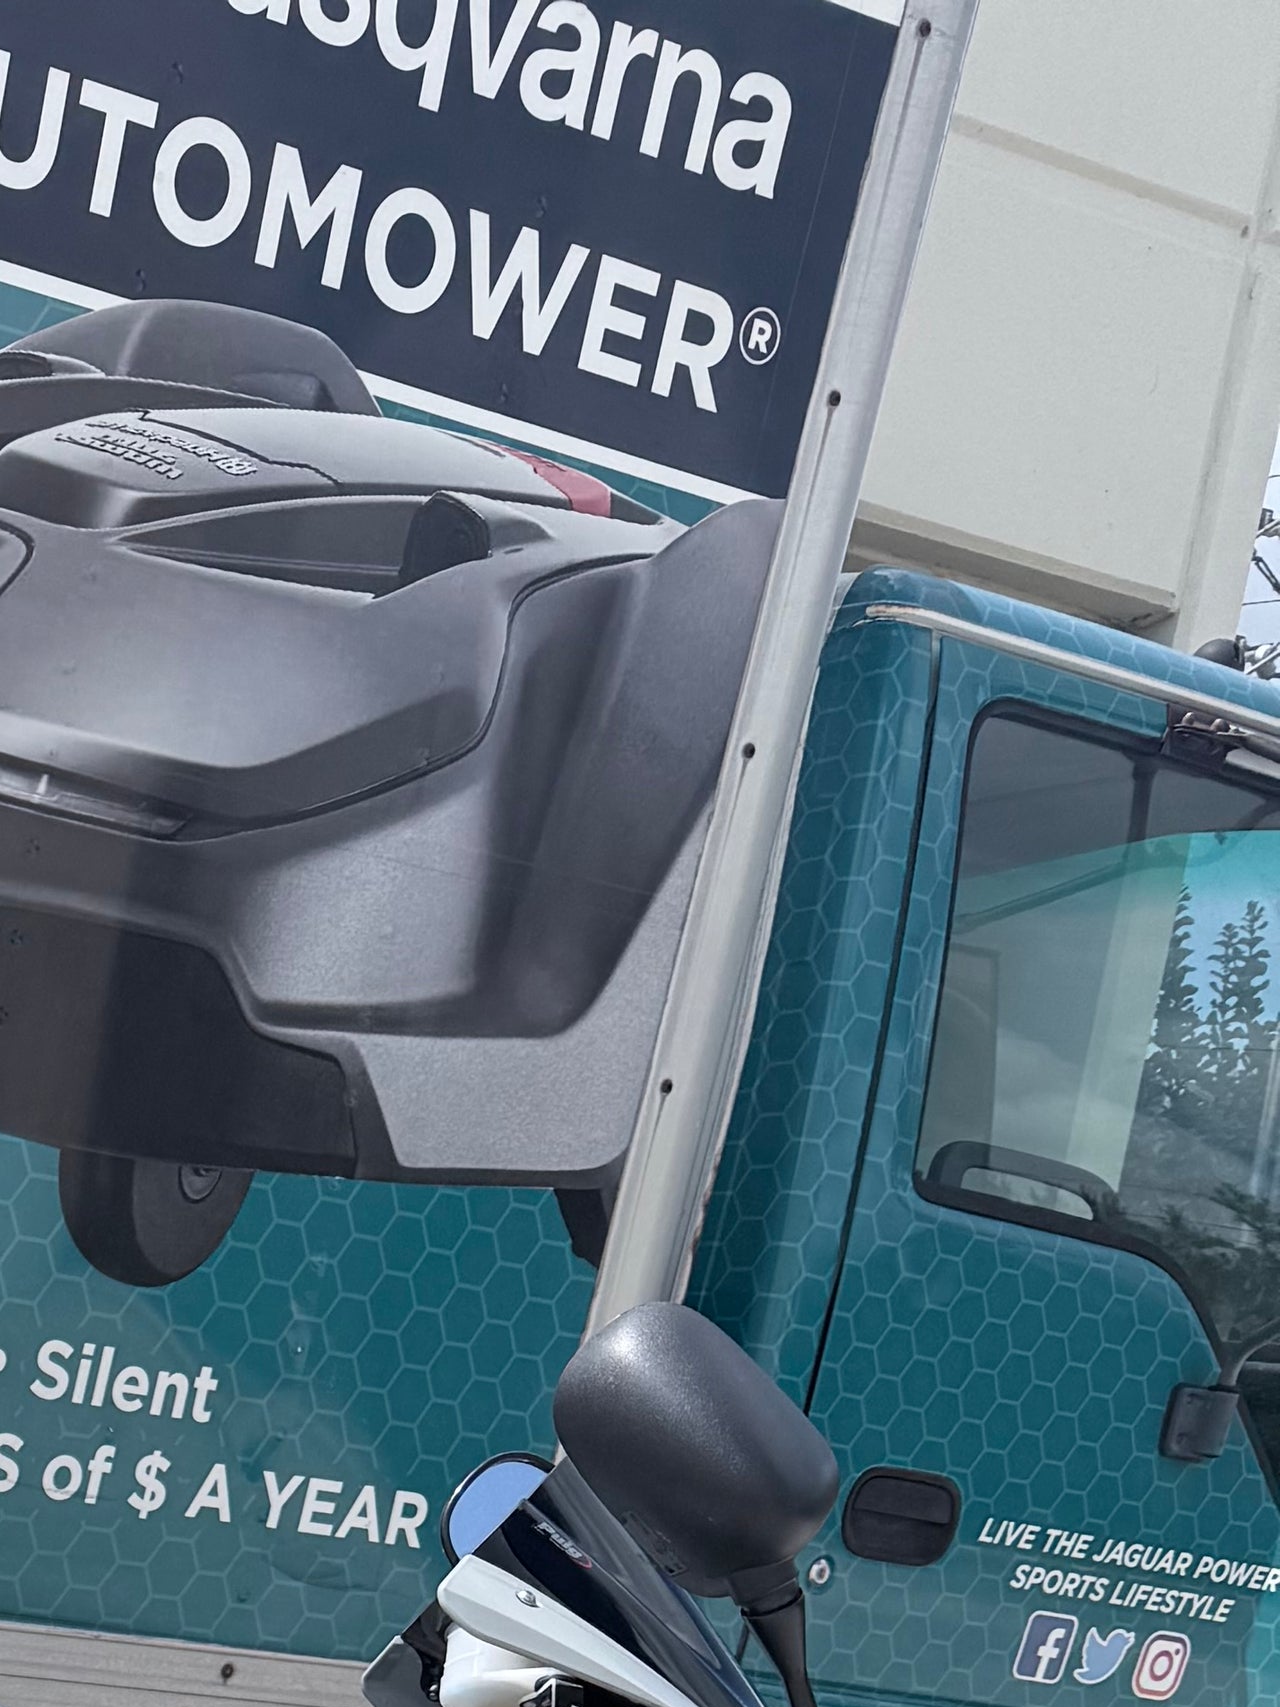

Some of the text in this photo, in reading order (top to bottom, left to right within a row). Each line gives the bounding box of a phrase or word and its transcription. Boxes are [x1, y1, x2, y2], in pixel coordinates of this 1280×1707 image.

[30, 1339, 218, 1425] Silent
[42, 1444, 114, 1505] of
[129, 1449, 172, 1520] $
[185, 1463, 232, 1523] A
[262, 1471, 429, 1549] YEAR
[977, 1517, 1280, 1593] LIVE THE JAGUAR POWER
[1010, 1563, 1236, 1623] SPORTS LIFESTYLE
